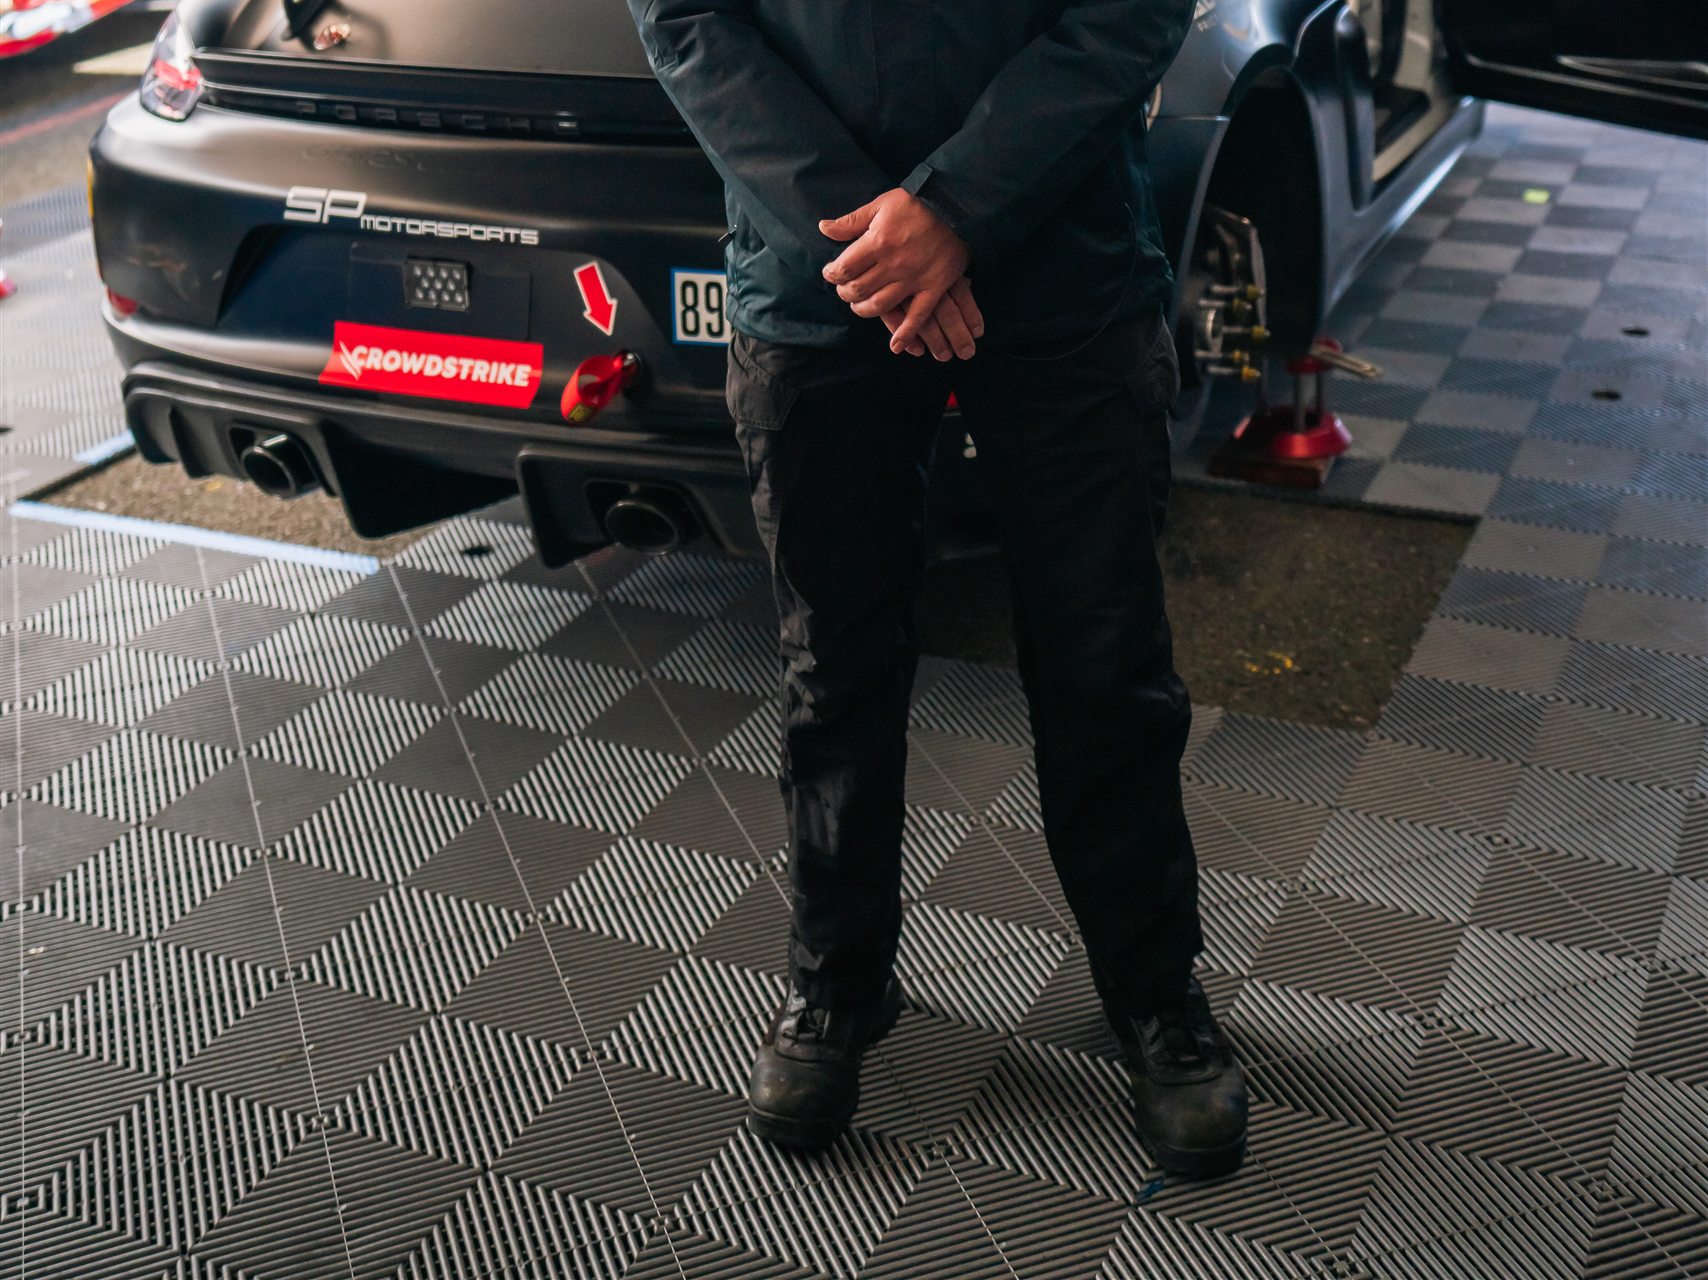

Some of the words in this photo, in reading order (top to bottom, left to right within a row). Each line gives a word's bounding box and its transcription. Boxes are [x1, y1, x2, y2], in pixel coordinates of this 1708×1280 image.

[284, 185, 368, 224] SP
[360, 214, 540, 246] MOTORSPORTS
[681, 280, 725, 338] 89
[350, 334, 534, 387] CROWDSTRIKE
